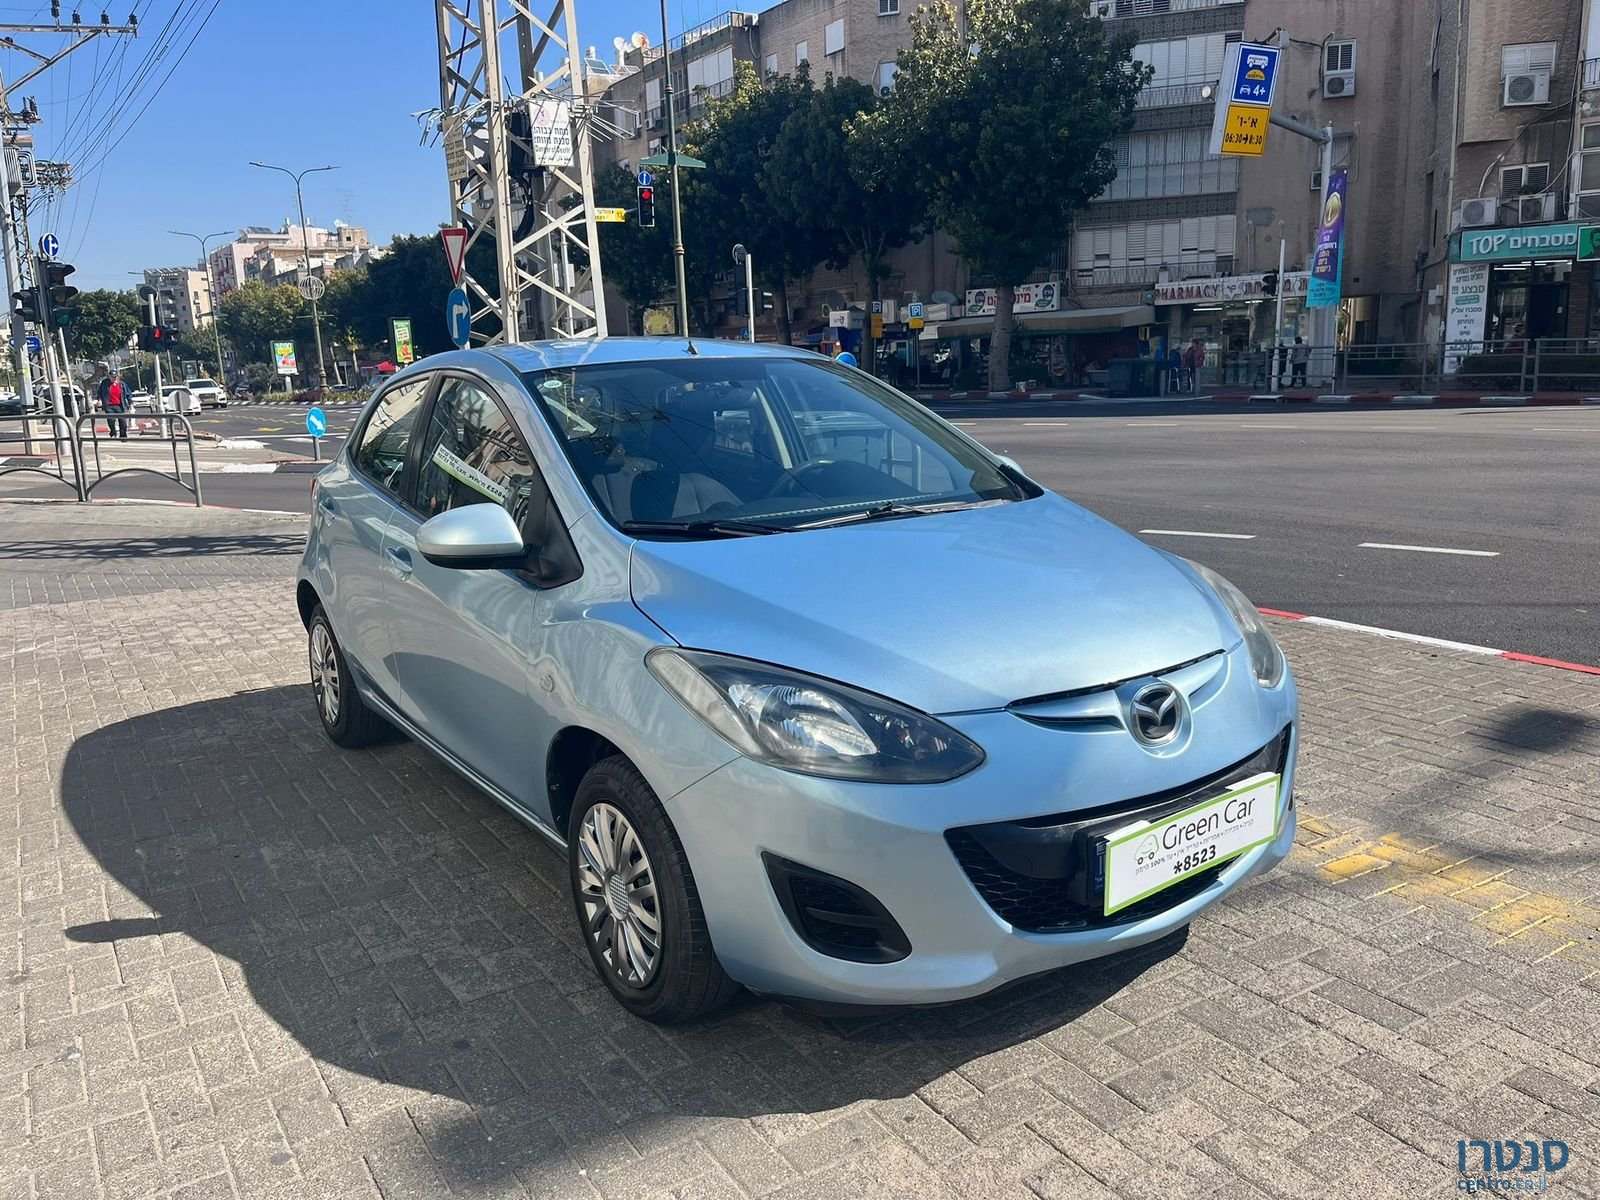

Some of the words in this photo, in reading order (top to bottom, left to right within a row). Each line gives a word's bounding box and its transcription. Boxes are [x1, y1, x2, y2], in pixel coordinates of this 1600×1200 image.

[1253, 84, 1266, 97] 4+
[1469, 234, 1507, 255] TOP
[1154, 283, 1219, 300] PHARMACY
[1163, 813, 1219, 850] Green
[1224, 797, 1256, 824] Car
